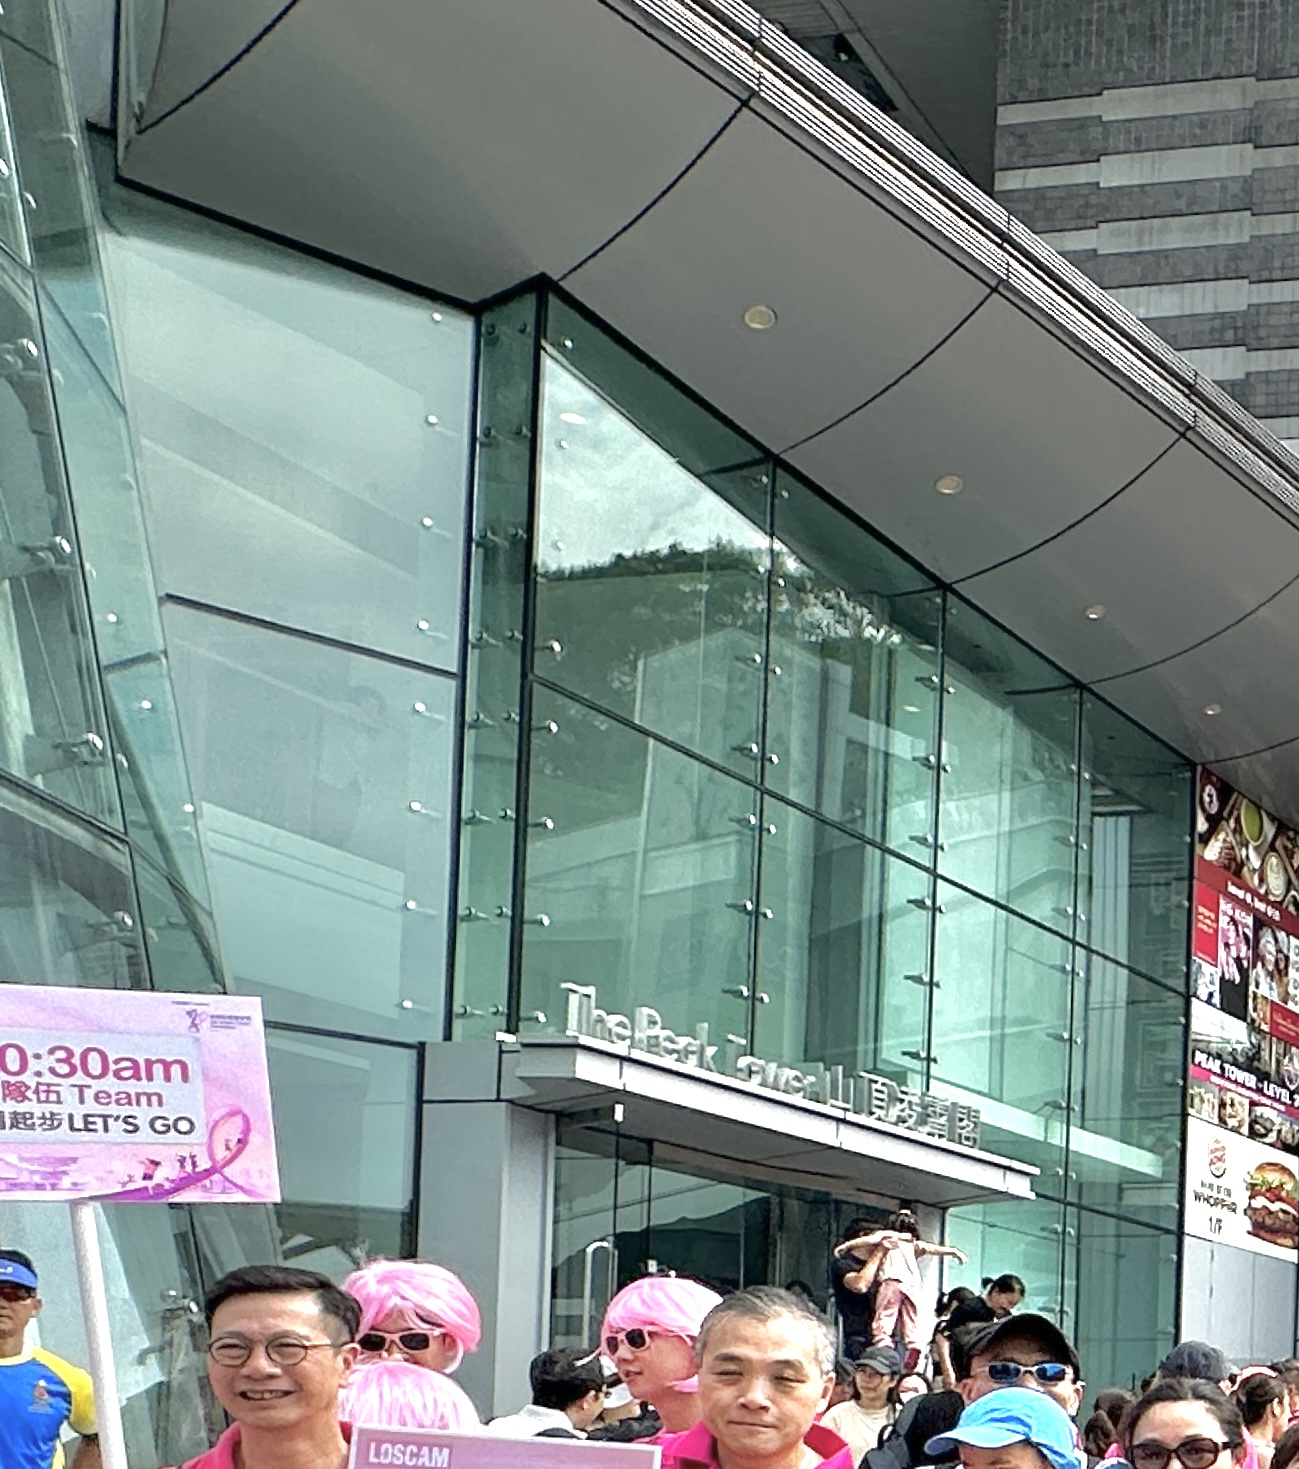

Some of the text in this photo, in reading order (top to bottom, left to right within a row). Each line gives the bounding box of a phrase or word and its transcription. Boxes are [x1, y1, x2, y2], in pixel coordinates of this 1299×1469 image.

[633, 1006, 718, 1071] Peak
[1193, 1050, 1222, 1075] PEAK
[1223, 1062, 1257, 1090] TOWER
[70, 1083, 164, 1108] Team
[0, 1110, 196, 1136] 起步 LET'S GO
[368, 1441, 450, 1469] LOSCAM
